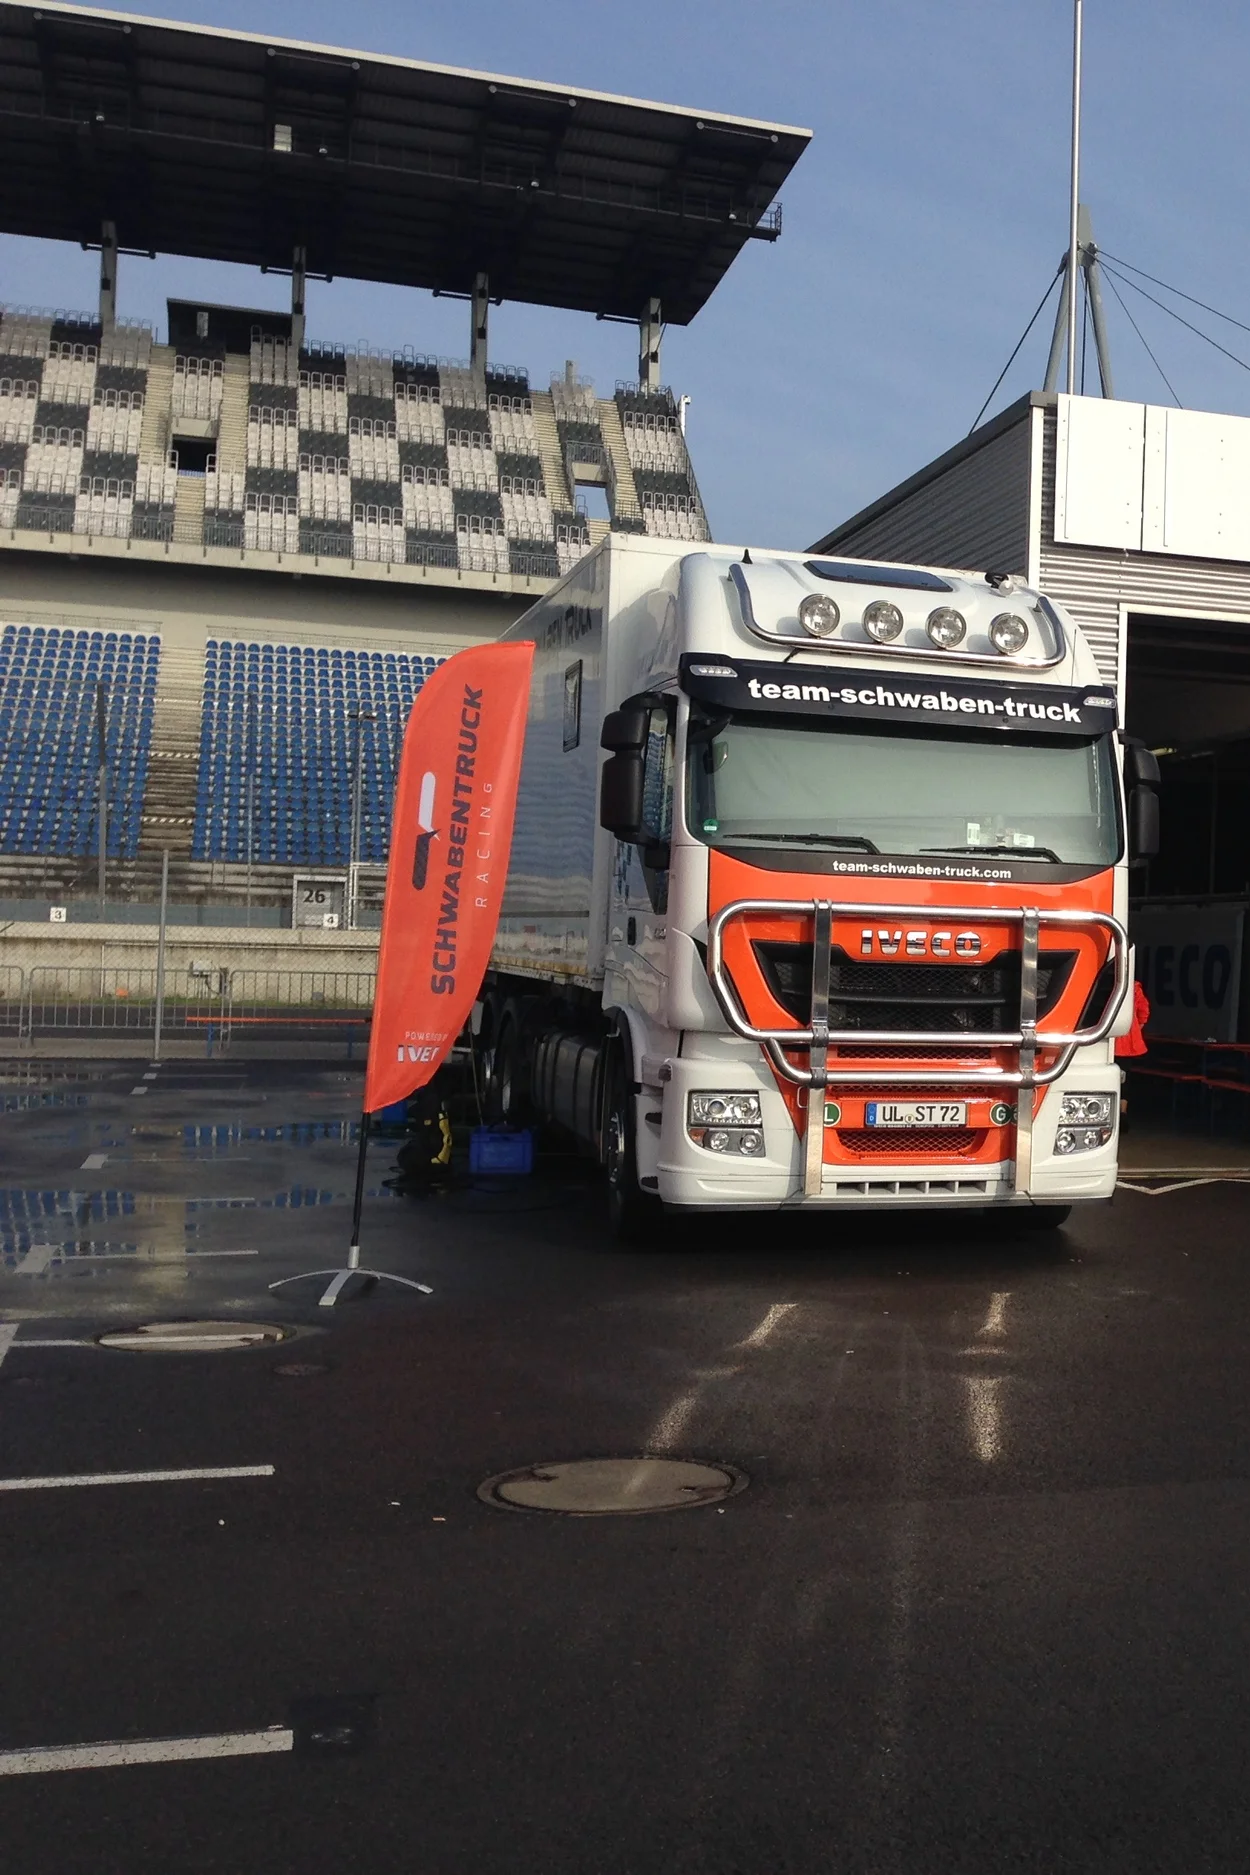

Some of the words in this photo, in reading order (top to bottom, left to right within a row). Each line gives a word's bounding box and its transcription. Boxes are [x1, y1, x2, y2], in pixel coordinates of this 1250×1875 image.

[748, 678, 1082, 723] team-schwaben-truck
[431, 682, 484, 995] SCHWABENTRUCK
[475, 782, 492, 908] RACING
[832, 860, 1012, 879] team-schwaben-truck.com
[303, 887, 326, 903] 26
[861, 929, 981, 957] IVECO
[1142, 944, 1232, 1010] ECO
[882, 1106, 904, 1122] UL
[915, 1106, 936, 1122] ST
[940, 1106, 960, 1122] 72
